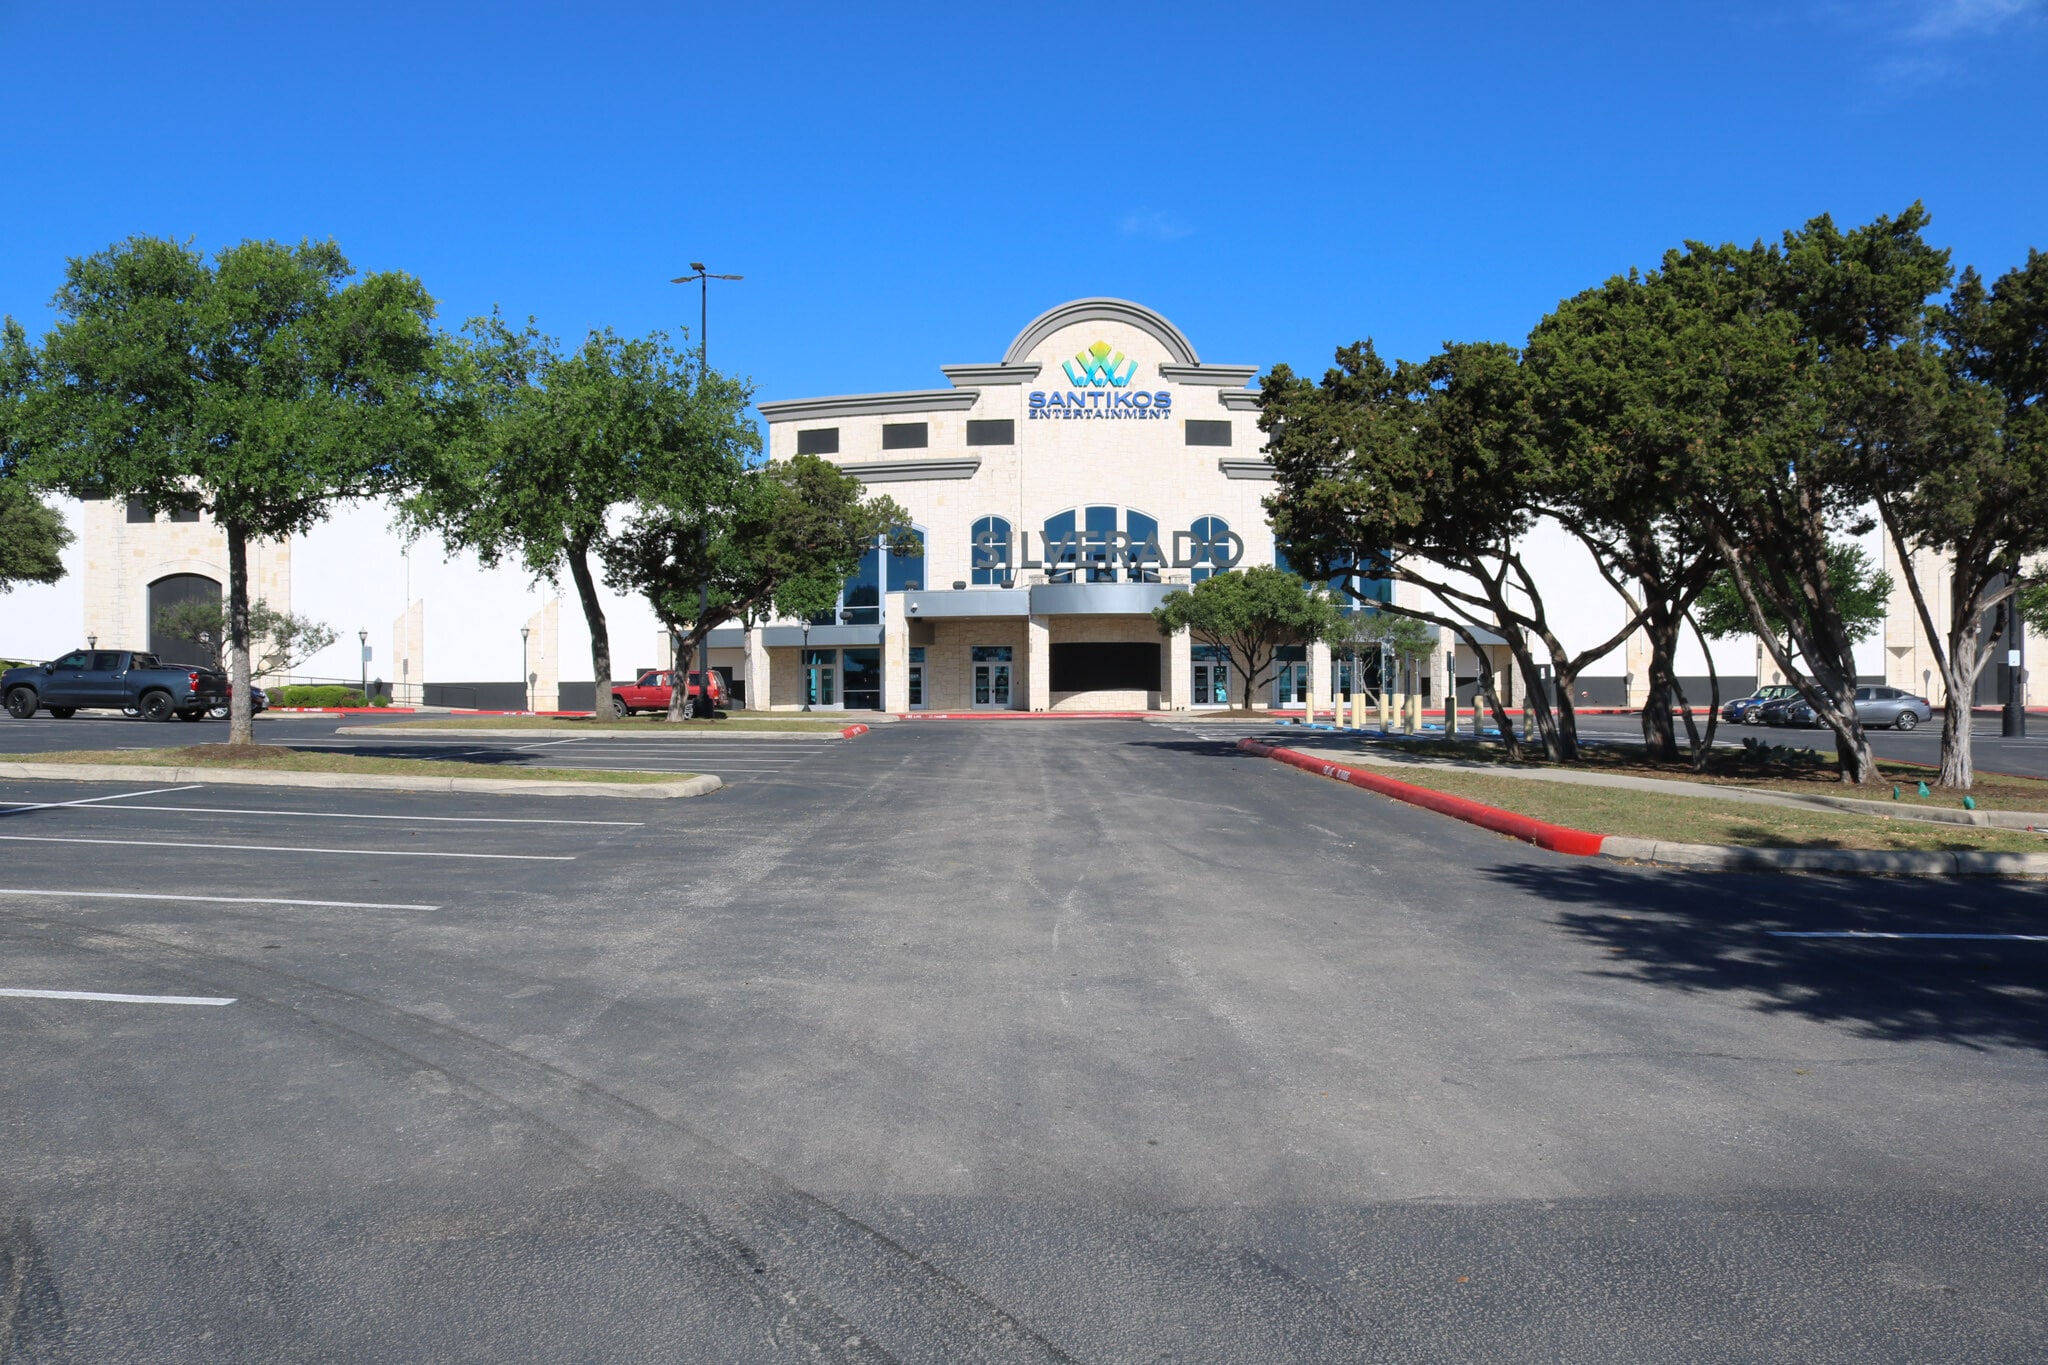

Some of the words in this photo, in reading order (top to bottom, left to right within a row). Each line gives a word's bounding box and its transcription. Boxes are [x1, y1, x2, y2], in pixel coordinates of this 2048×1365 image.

[1028, 391, 1172, 408] SANTIKOS
[1028, 408, 1171, 420] ENTERTAINMENT
[975, 530, 1244, 569] SILVERADO
